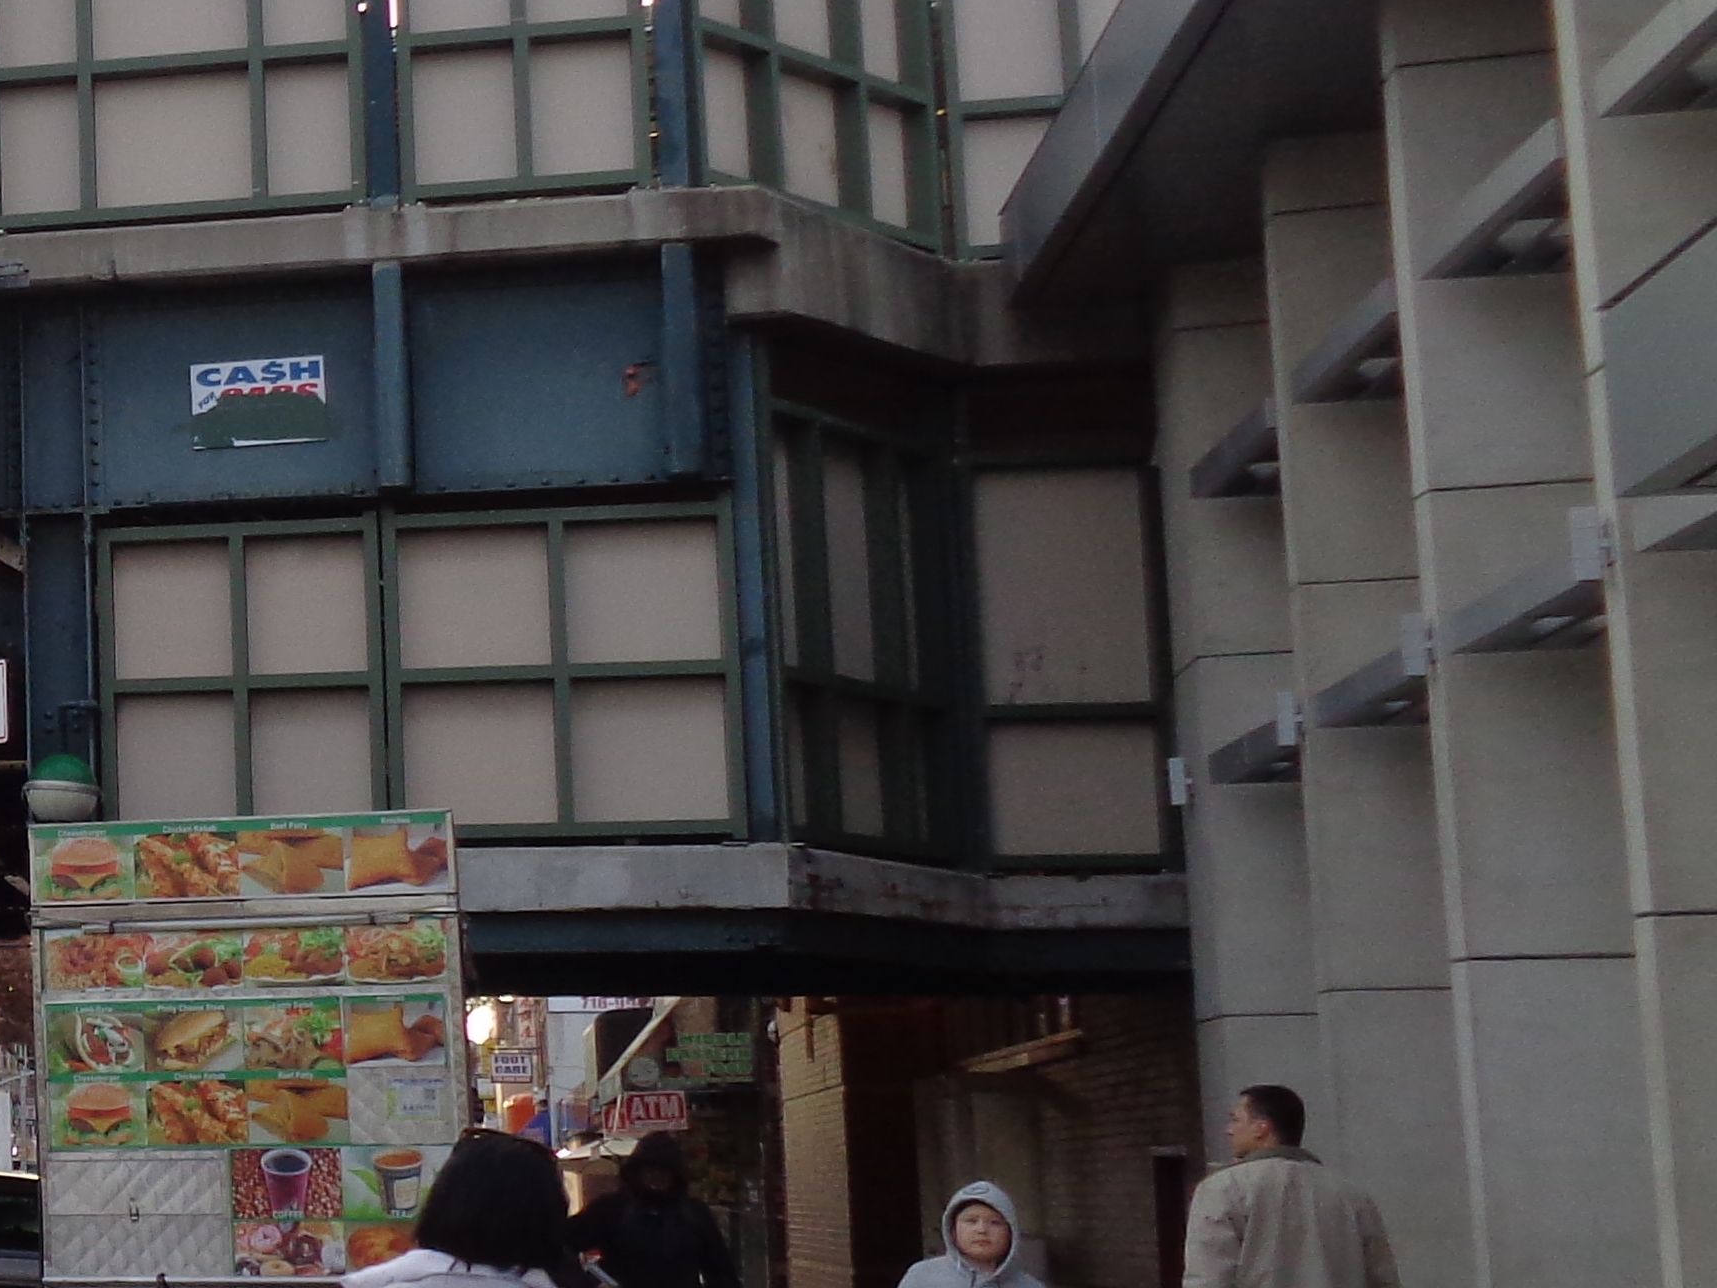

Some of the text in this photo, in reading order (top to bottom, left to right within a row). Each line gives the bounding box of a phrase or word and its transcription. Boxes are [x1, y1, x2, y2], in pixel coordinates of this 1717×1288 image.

[196, 360, 320, 387] CA$H
[495, 1065, 529, 1074] CARE
[631, 1095, 680, 1120] ATM
[272, 1210, 305, 1219] COFFEE
